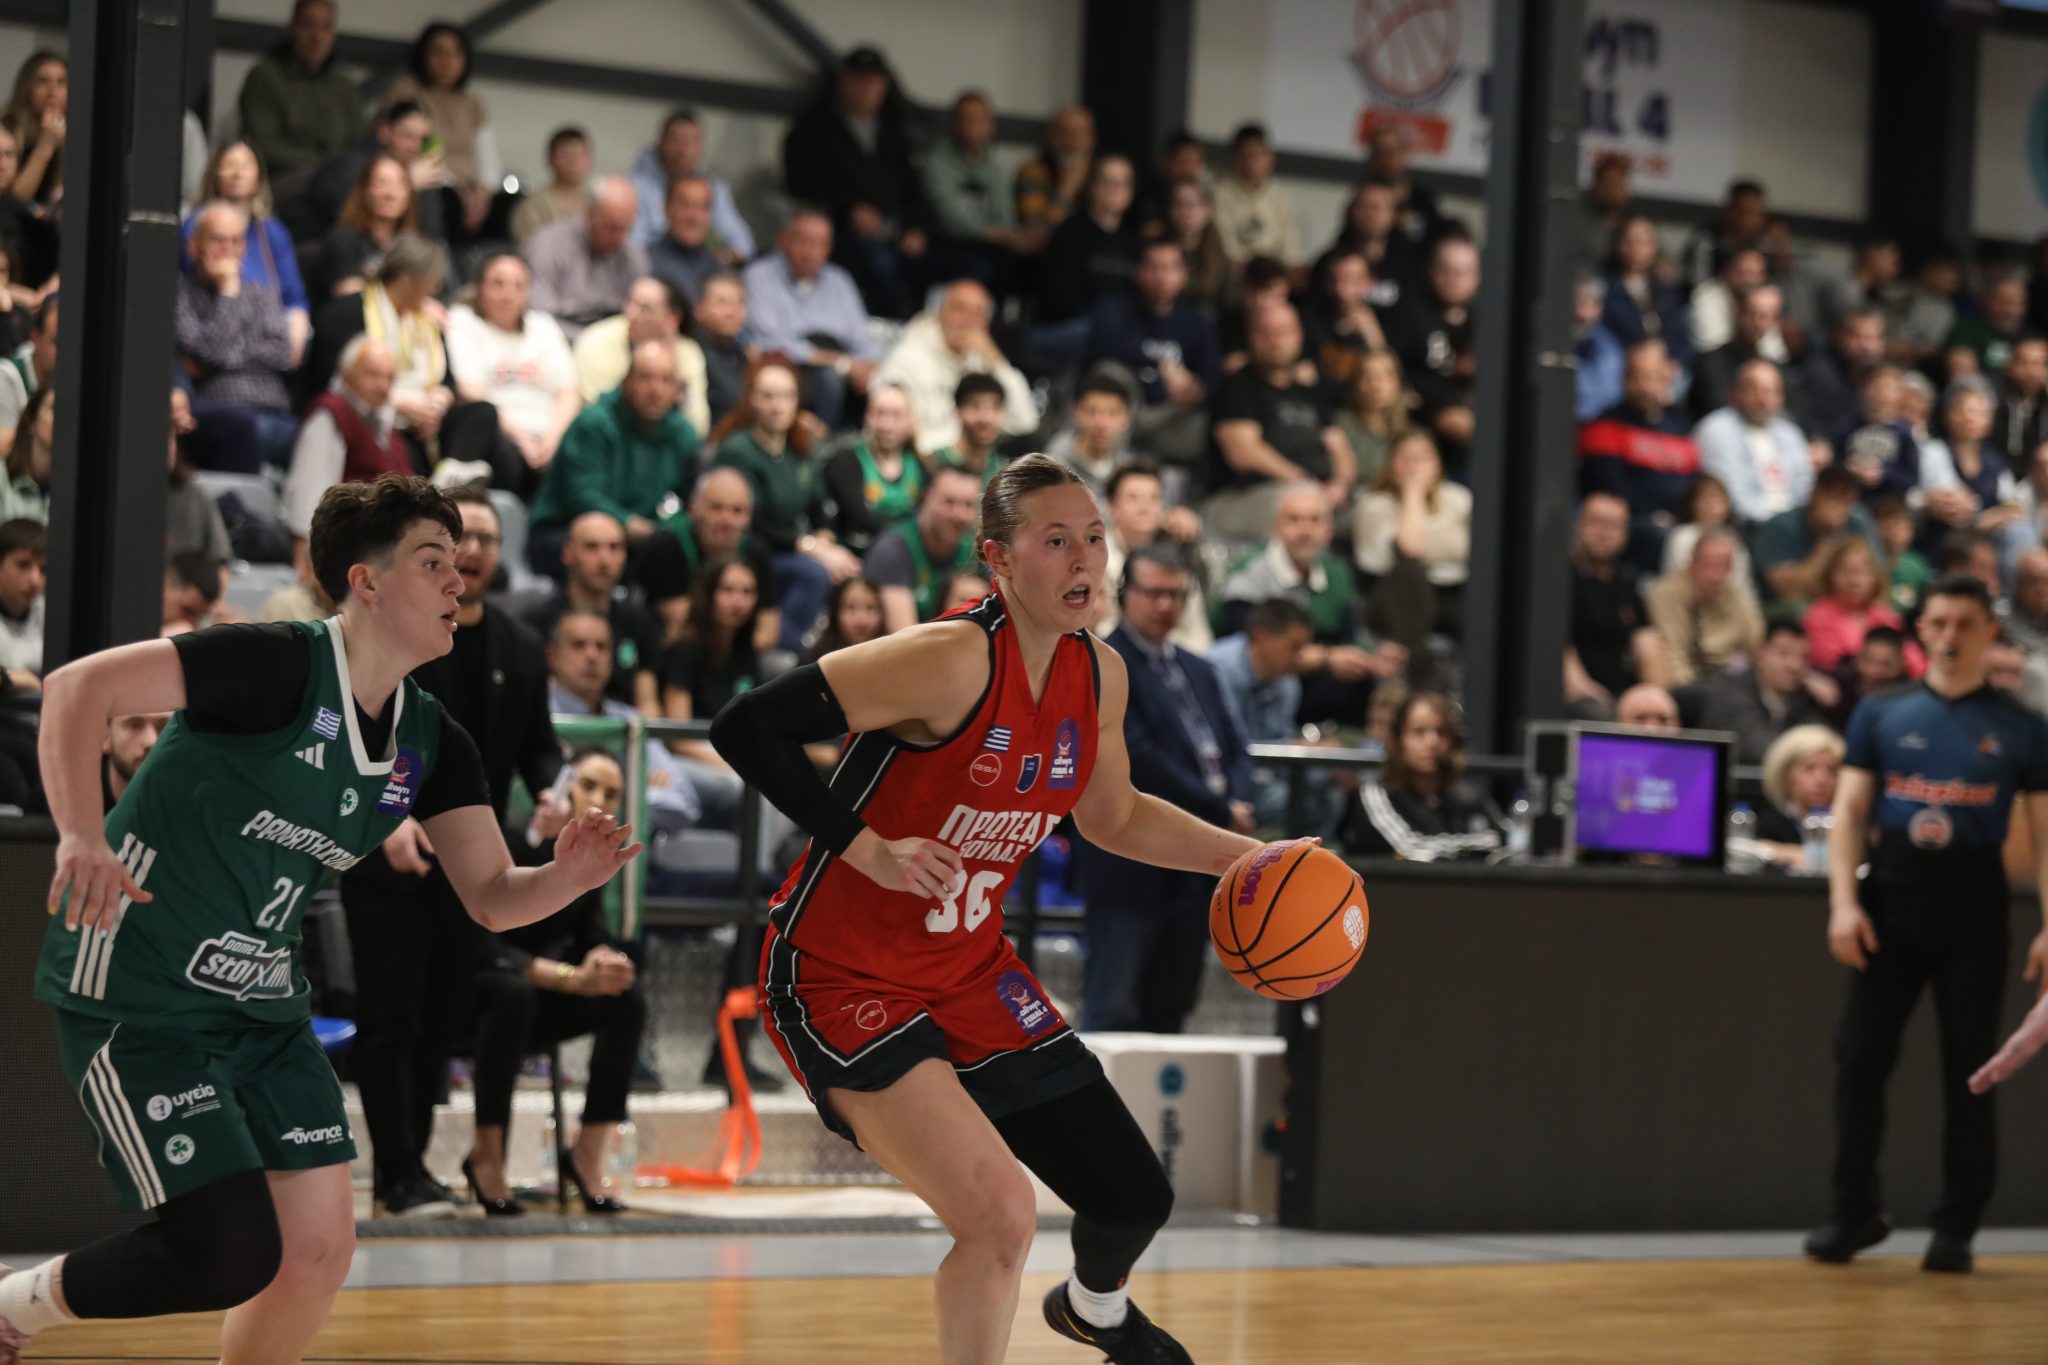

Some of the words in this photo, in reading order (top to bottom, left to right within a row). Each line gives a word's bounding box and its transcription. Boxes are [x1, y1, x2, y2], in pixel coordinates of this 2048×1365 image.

[256, 876, 306, 932] 21
[924, 869, 1005, 933] 36
[1020, 1000, 1042, 1016] allwyn
[1023, 1009, 1044, 1027] FINAL
[294, 1124, 343, 1144] avance
